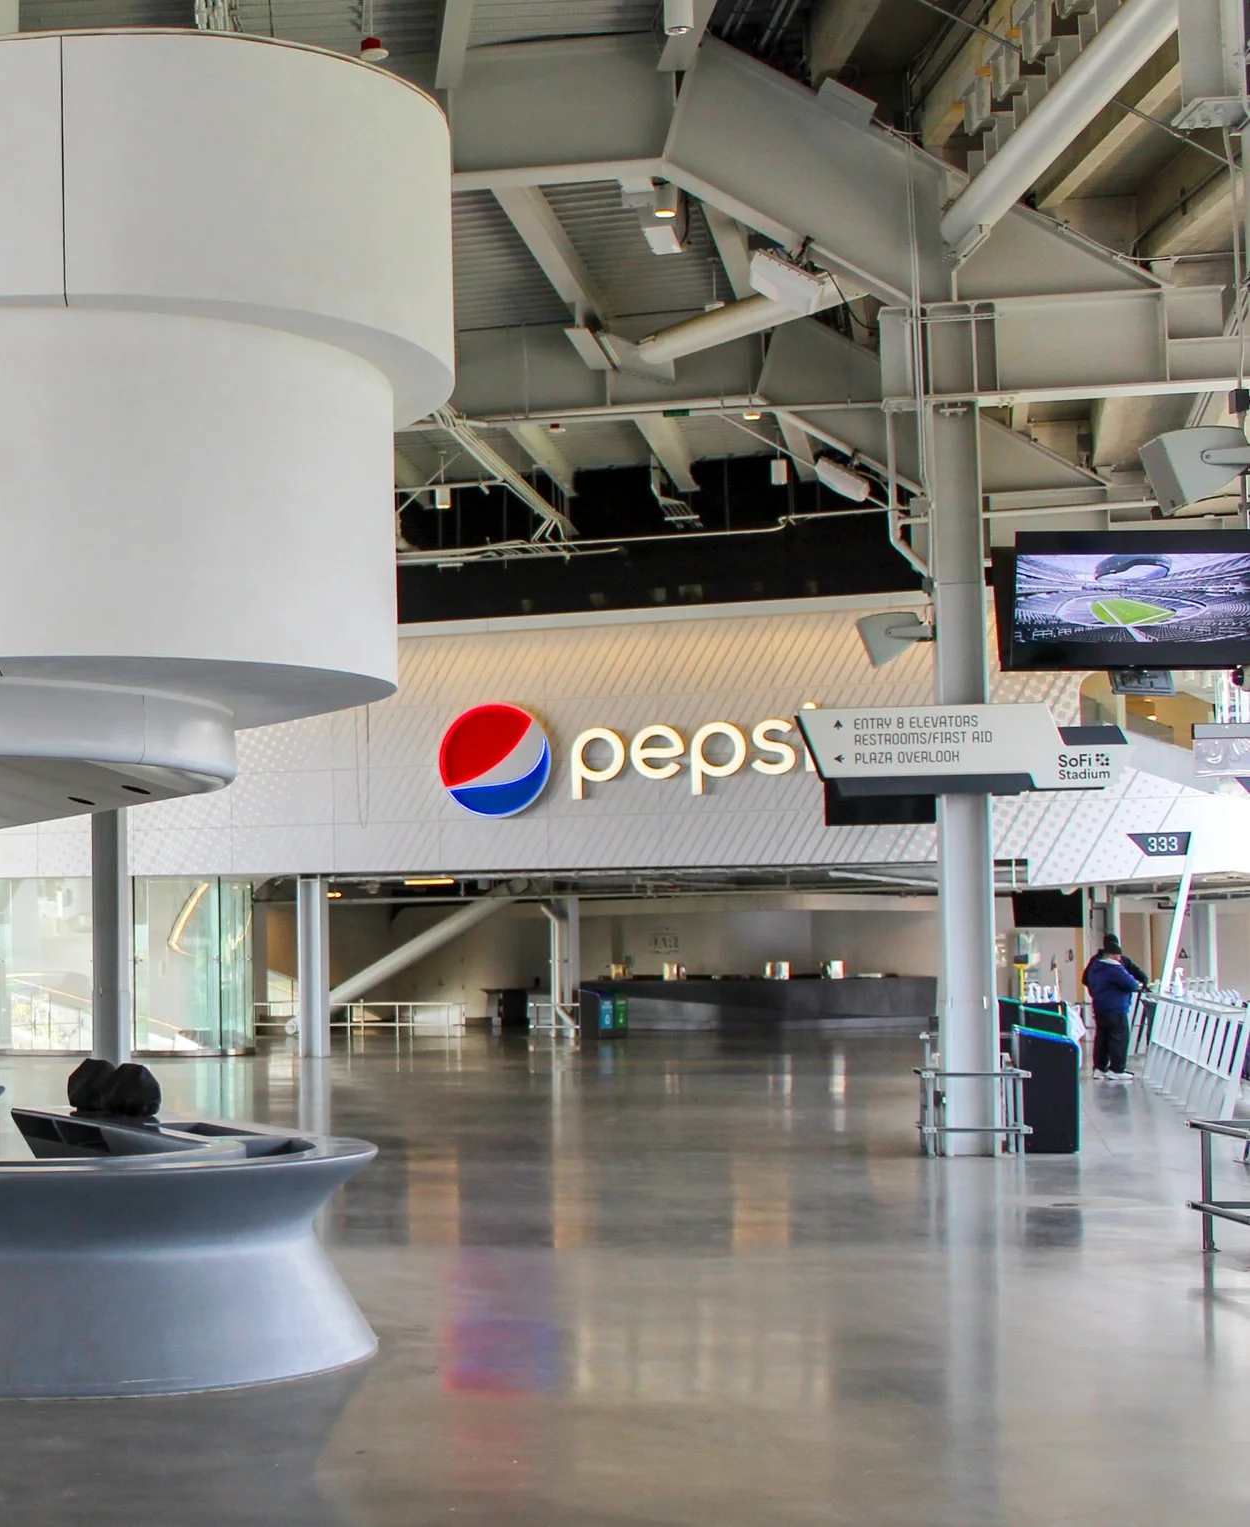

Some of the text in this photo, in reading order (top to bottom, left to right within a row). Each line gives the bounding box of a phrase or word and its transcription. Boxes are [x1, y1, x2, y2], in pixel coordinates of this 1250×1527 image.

[853, 717, 892, 730] ENTRY
[909, 715, 979, 729] ELEVATORS
[854, 730, 993, 746] RESTROOMS/FIRST AID
[854, 750, 960, 764] PLAZA OVERLOOK
[1058, 753, 1092, 768] SoFi
[1058, 769, 1111, 780] Stadium
[1147, 836, 1178, 852] 333
